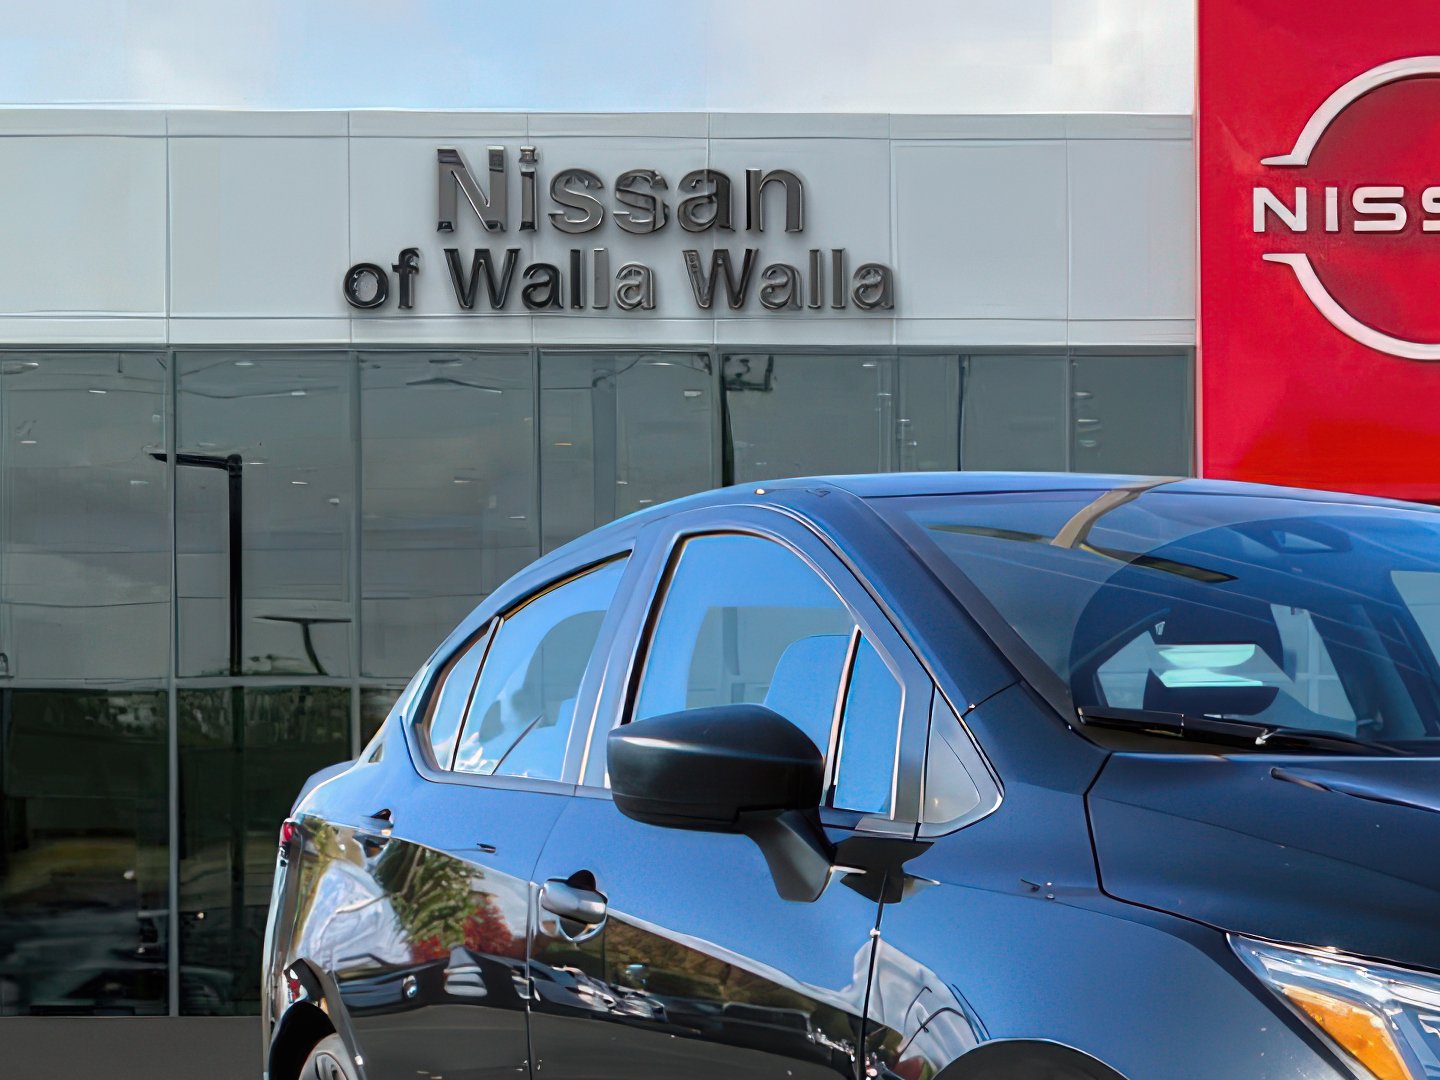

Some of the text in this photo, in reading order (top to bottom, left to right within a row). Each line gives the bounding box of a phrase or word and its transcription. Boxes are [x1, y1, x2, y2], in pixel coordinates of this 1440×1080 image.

[437, 145, 806, 233] Nissan
[342, 248, 895, 311] of Walla Walla
